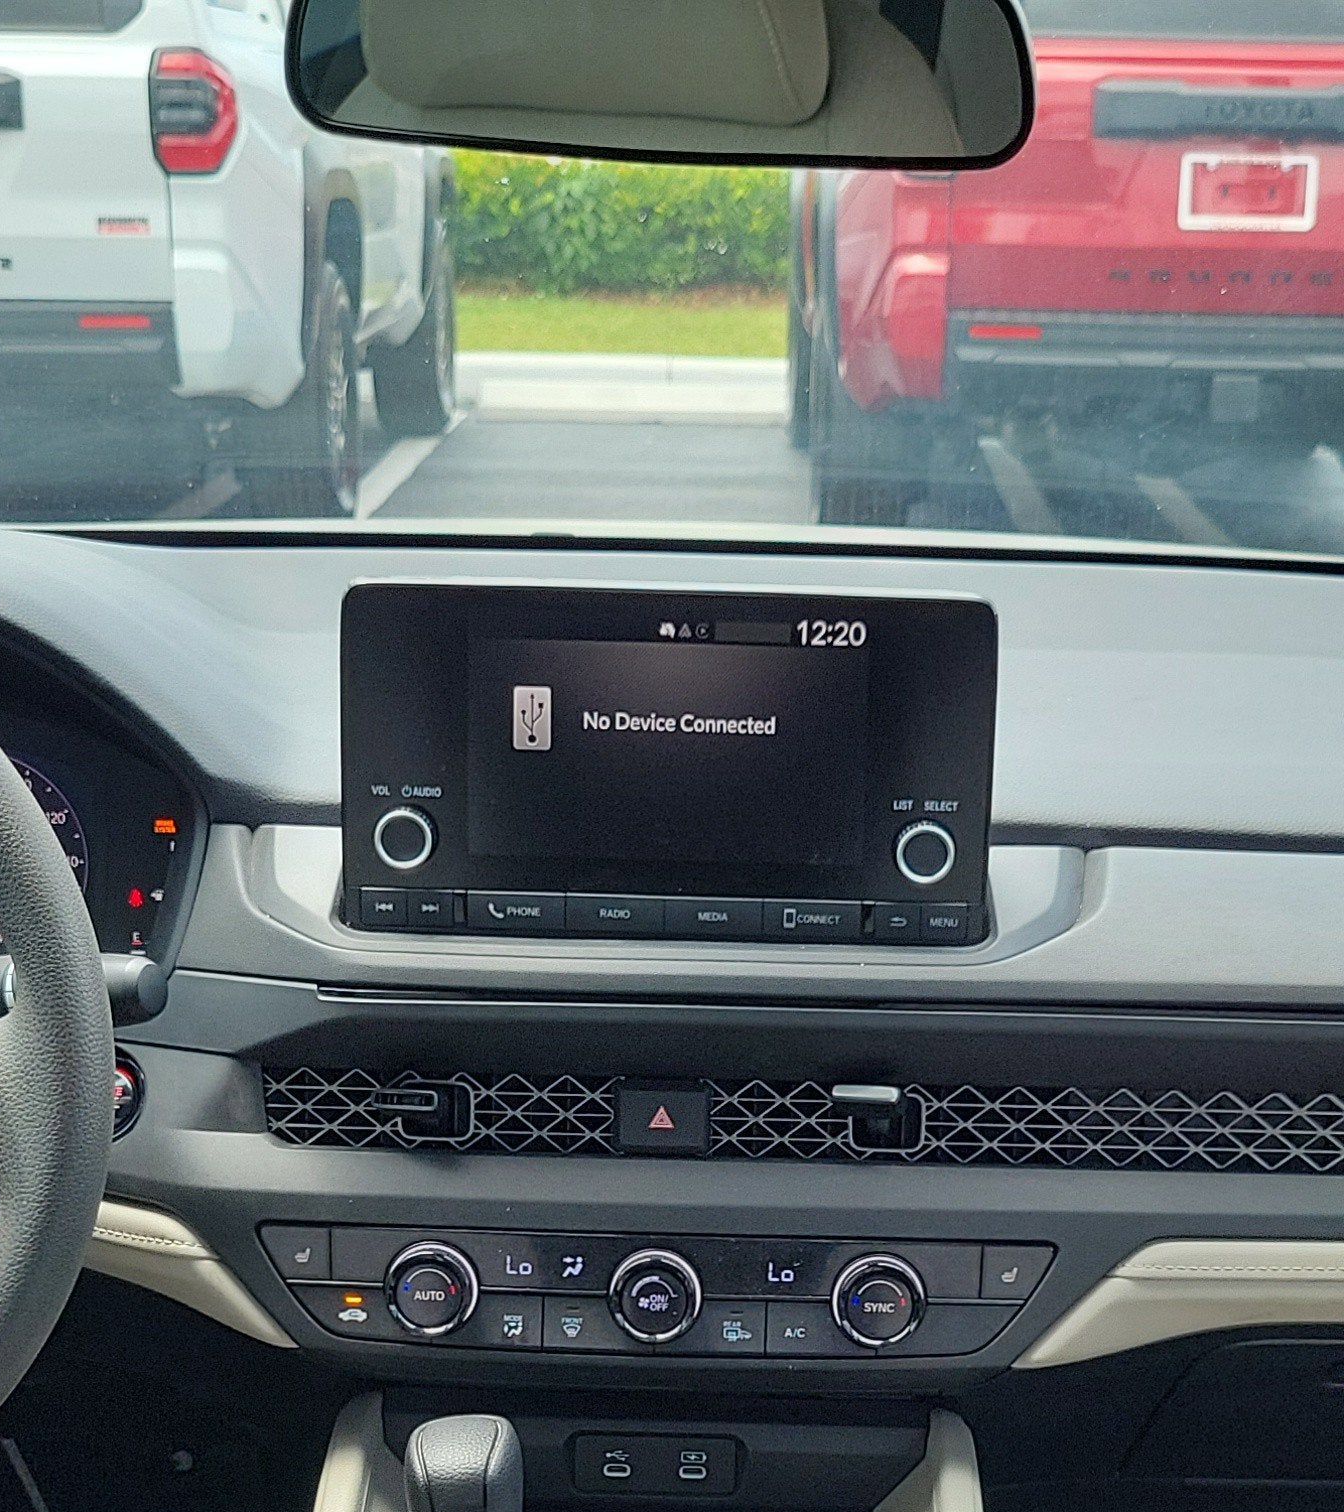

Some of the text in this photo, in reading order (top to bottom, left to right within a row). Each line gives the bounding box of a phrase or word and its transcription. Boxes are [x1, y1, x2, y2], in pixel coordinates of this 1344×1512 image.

[796, 619, 867, 647] 12:20
[583, 711, 776, 735] No Device Connected
[371, 785, 442, 798] VOL AUDIO
[893, 800, 959, 812] LIST SELECT
[506, 906, 541, 917] PHONE
[599, 908, 631, 919] RADIO
[698, 911, 729, 921] MEDIA
[797, 914, 842, 925] CONNECT
[929, 917, 959, 928] MENU
[132, 931, 141, 940] E
[506, 1255, 533, 1275] Lo
[768, 1262, 794, 1282] Lo
[413, 1291, 445, 1301] AUTO
[649, 1294, 669, 1303] ON/
[649, 1303, 669, 1312] OFF
[863, 1302, 895, 1313] SYNC
[784, 1328, 806, 1338] A/C
